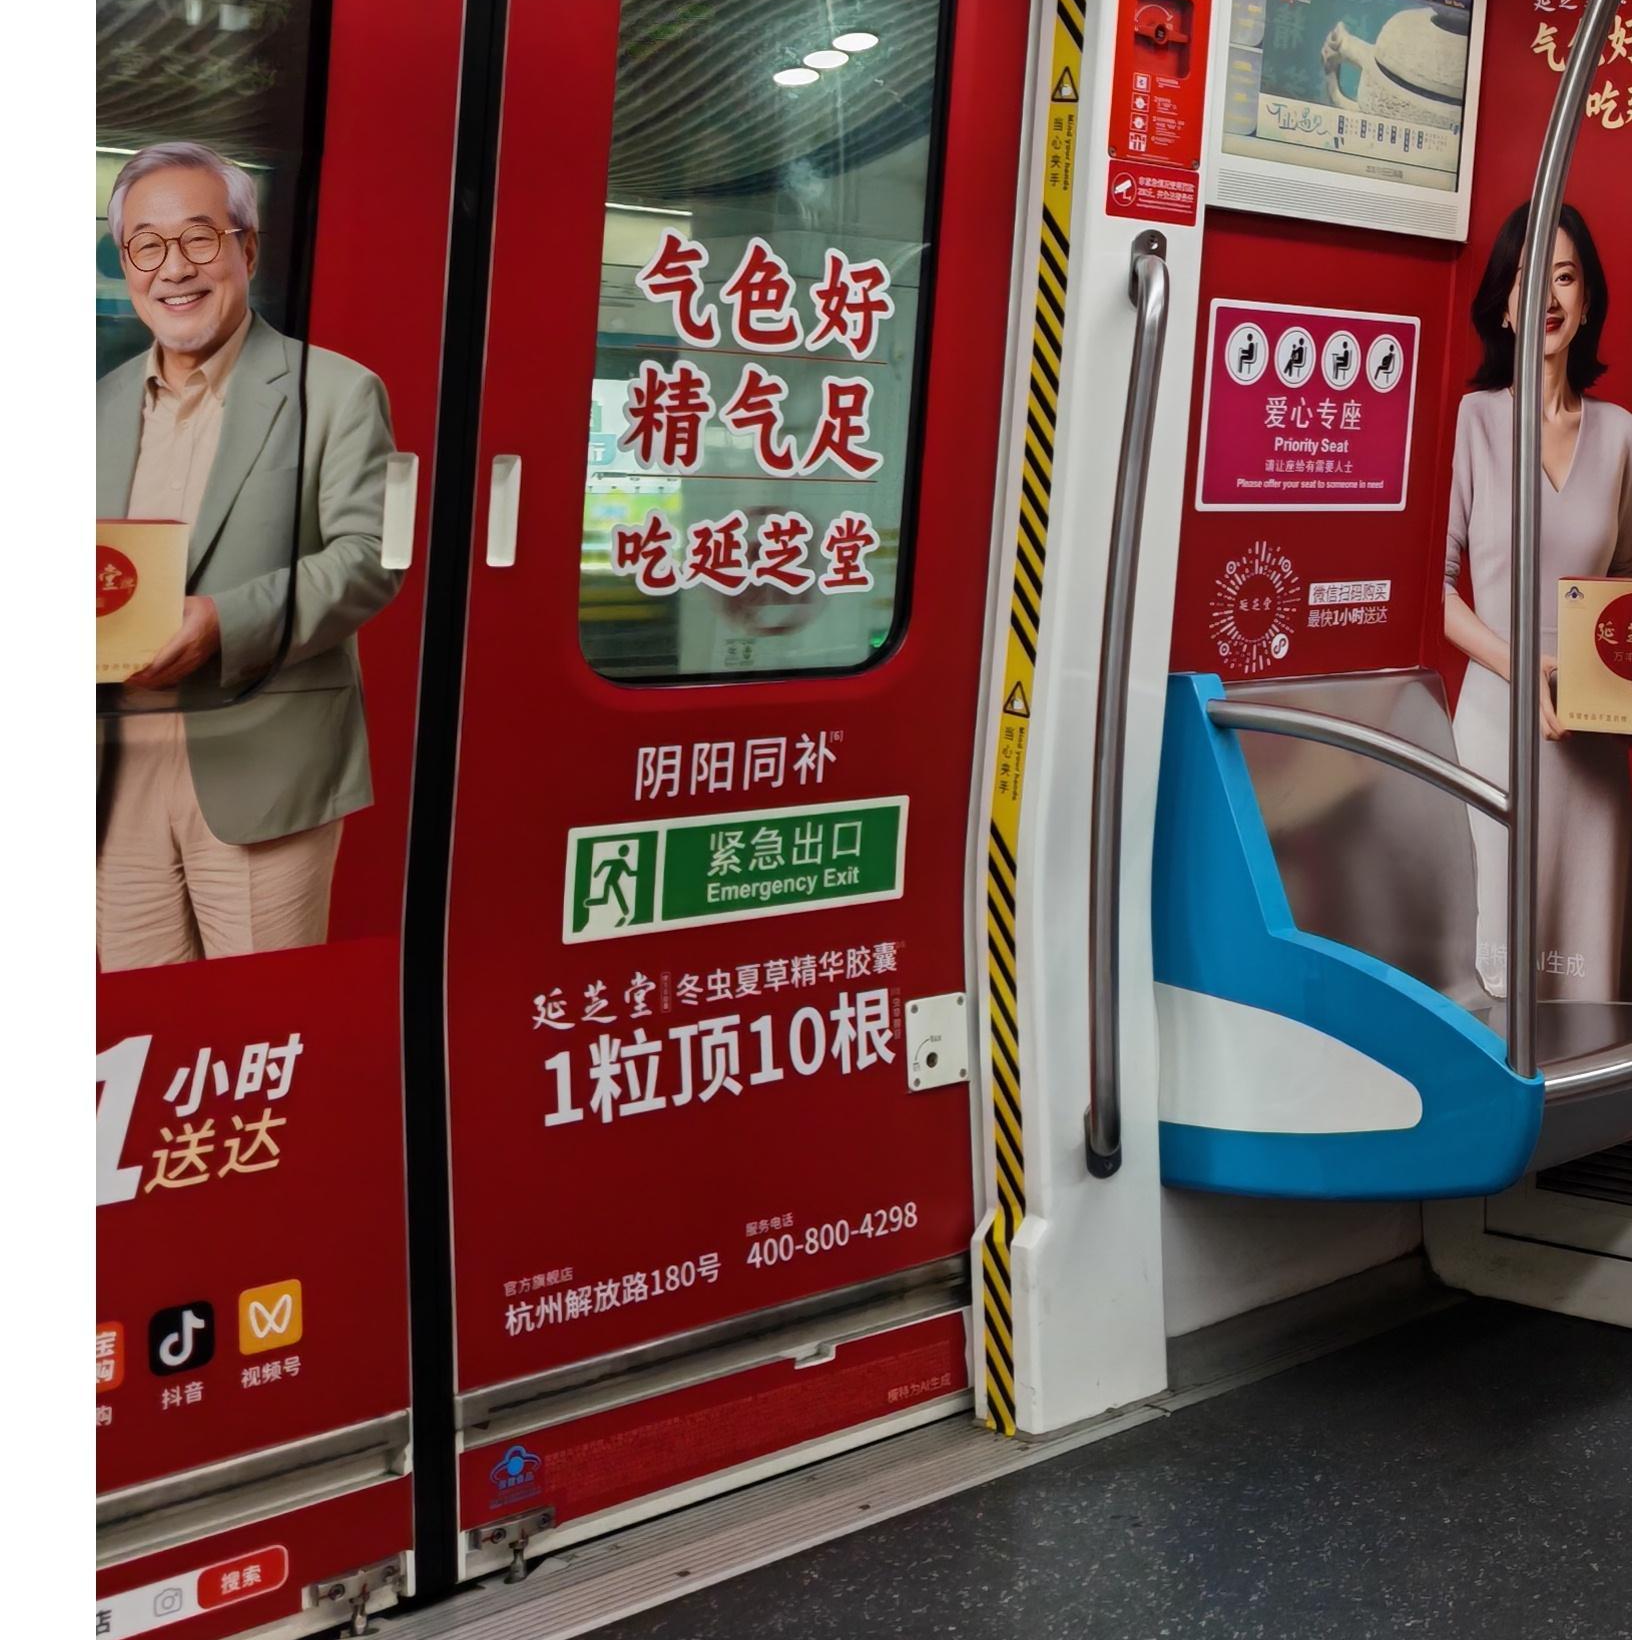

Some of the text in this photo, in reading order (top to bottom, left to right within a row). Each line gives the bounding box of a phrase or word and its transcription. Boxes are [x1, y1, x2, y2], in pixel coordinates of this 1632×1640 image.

[639, 230, 893, 357] 气色好
[620, 363, 883, 476] 精气足
[1264, 395, 1363, 432] 爱心专座
[1274, 436, 1350, 455] Priority Seat
[1236, 478, 1263, 489] Please
[1263, 478, 1282, 489] offer
[1282, 478, 1300, 490] your
[1300, 478, 1317, 489] seat
[1317, 478, 1326, 489] to
[1326, 478, 1359, 489] someone
[1366, 478, 1385, 489] need
[1264, 459, 1353, 474] 请让座给有需要人士
[614, 510, 880, 594] 吃延芝堂
[1312, 583, 1388, 603] 微信扫码购买
[1307, 606, 1389, 628] 最快1小时送达
[635, 731, 838, 801] 阴阳同补
[707, 821, 863, 878] 紧急出口
[706, 866, 860, 904] Emergency Exit
[532, 971, 656, 1031] 延芝堂
[675, 941, 898, 1007] 冬虫夏草精华胶囊
[543, 988, 897, 1127] 1粒顶10根
[144, 1108, 287, 1194] 送达
[745, 1213, 794, 1237] 服务电话
[745, 1202, 918, 1270] 400-800-4298
[503, 1266, 574, 1298] 官方旗舰店
[504, 1252, 722, 1337] 杭州解放路180号
[241, 1356, 302, 1390] 视频号
[160, 1380, 205, 1411] 抖音
[220, 1565, 262, 1596] 搜索
